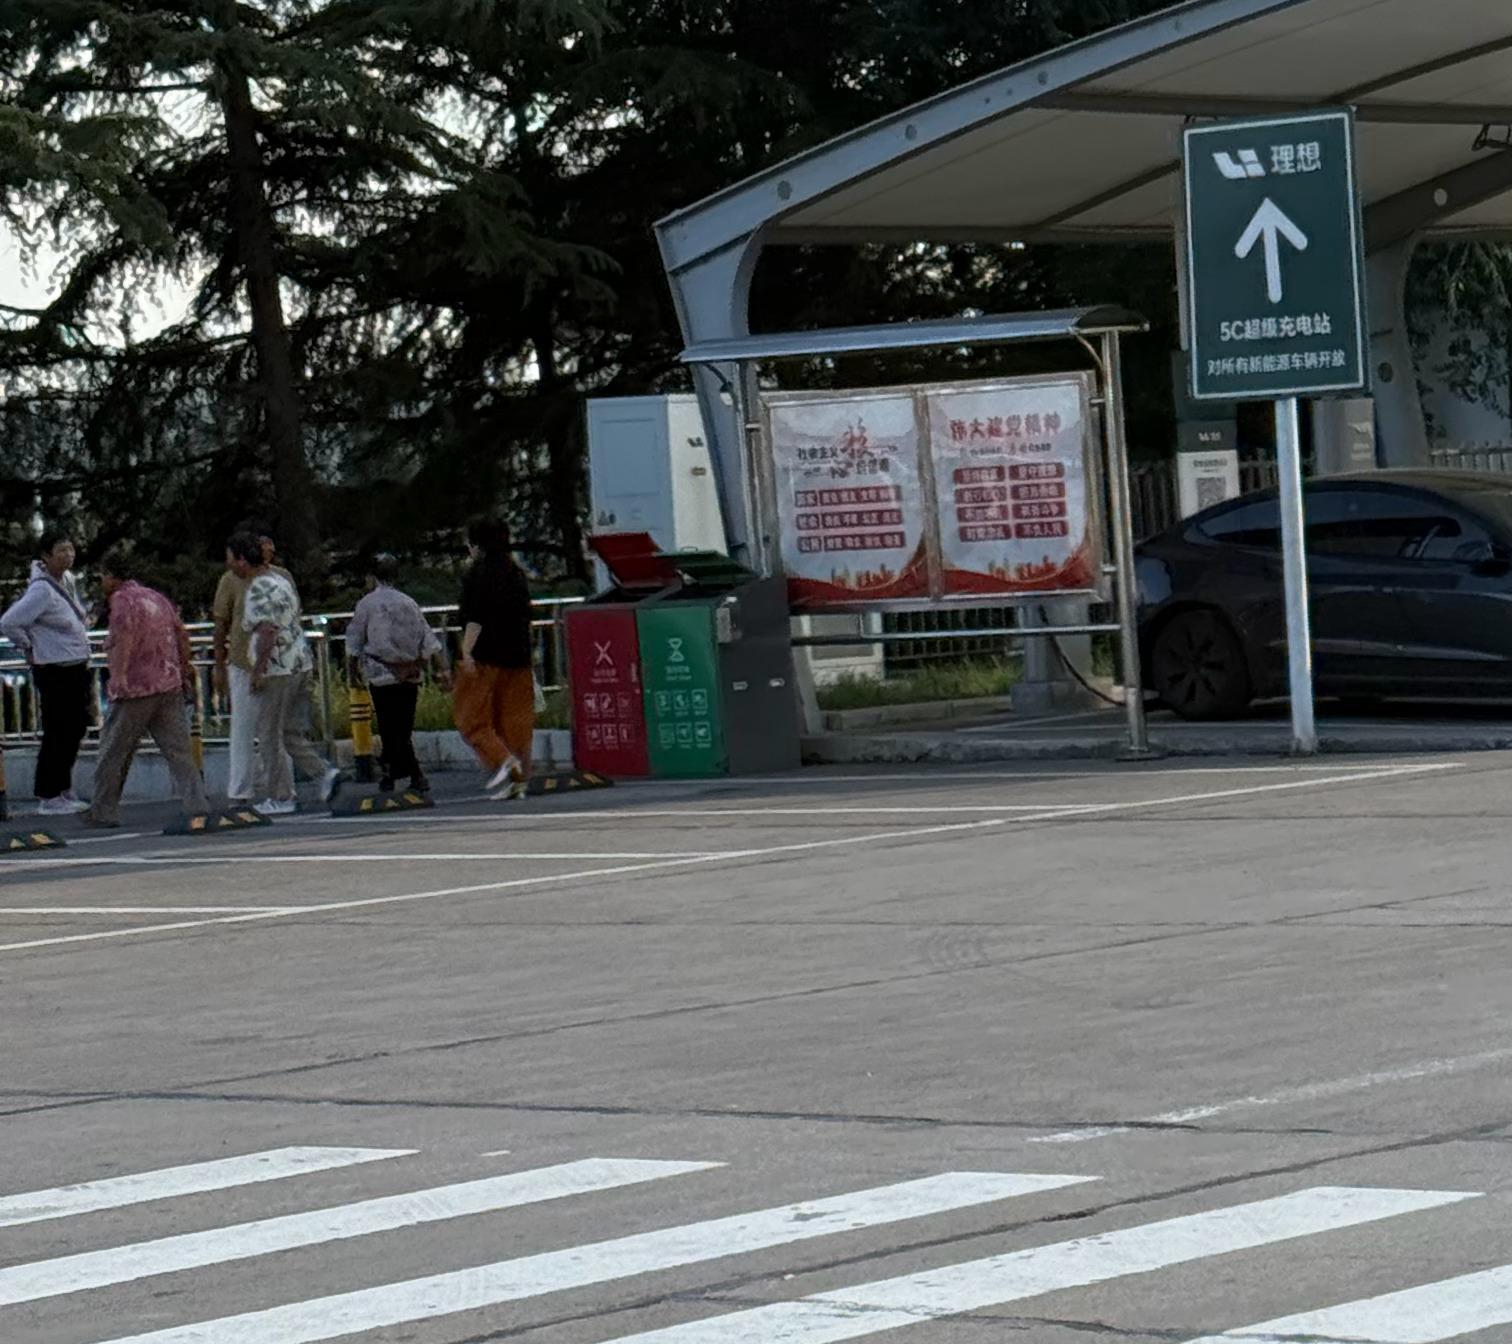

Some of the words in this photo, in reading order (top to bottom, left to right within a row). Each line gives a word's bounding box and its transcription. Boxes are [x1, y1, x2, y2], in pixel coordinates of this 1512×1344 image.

[1270, 141, 1322, 174] 理想
[1220, 312, 1332, 342] 5C超级充电站
[1207, 350, 1346, 376] 对所有新能源车辆开放
